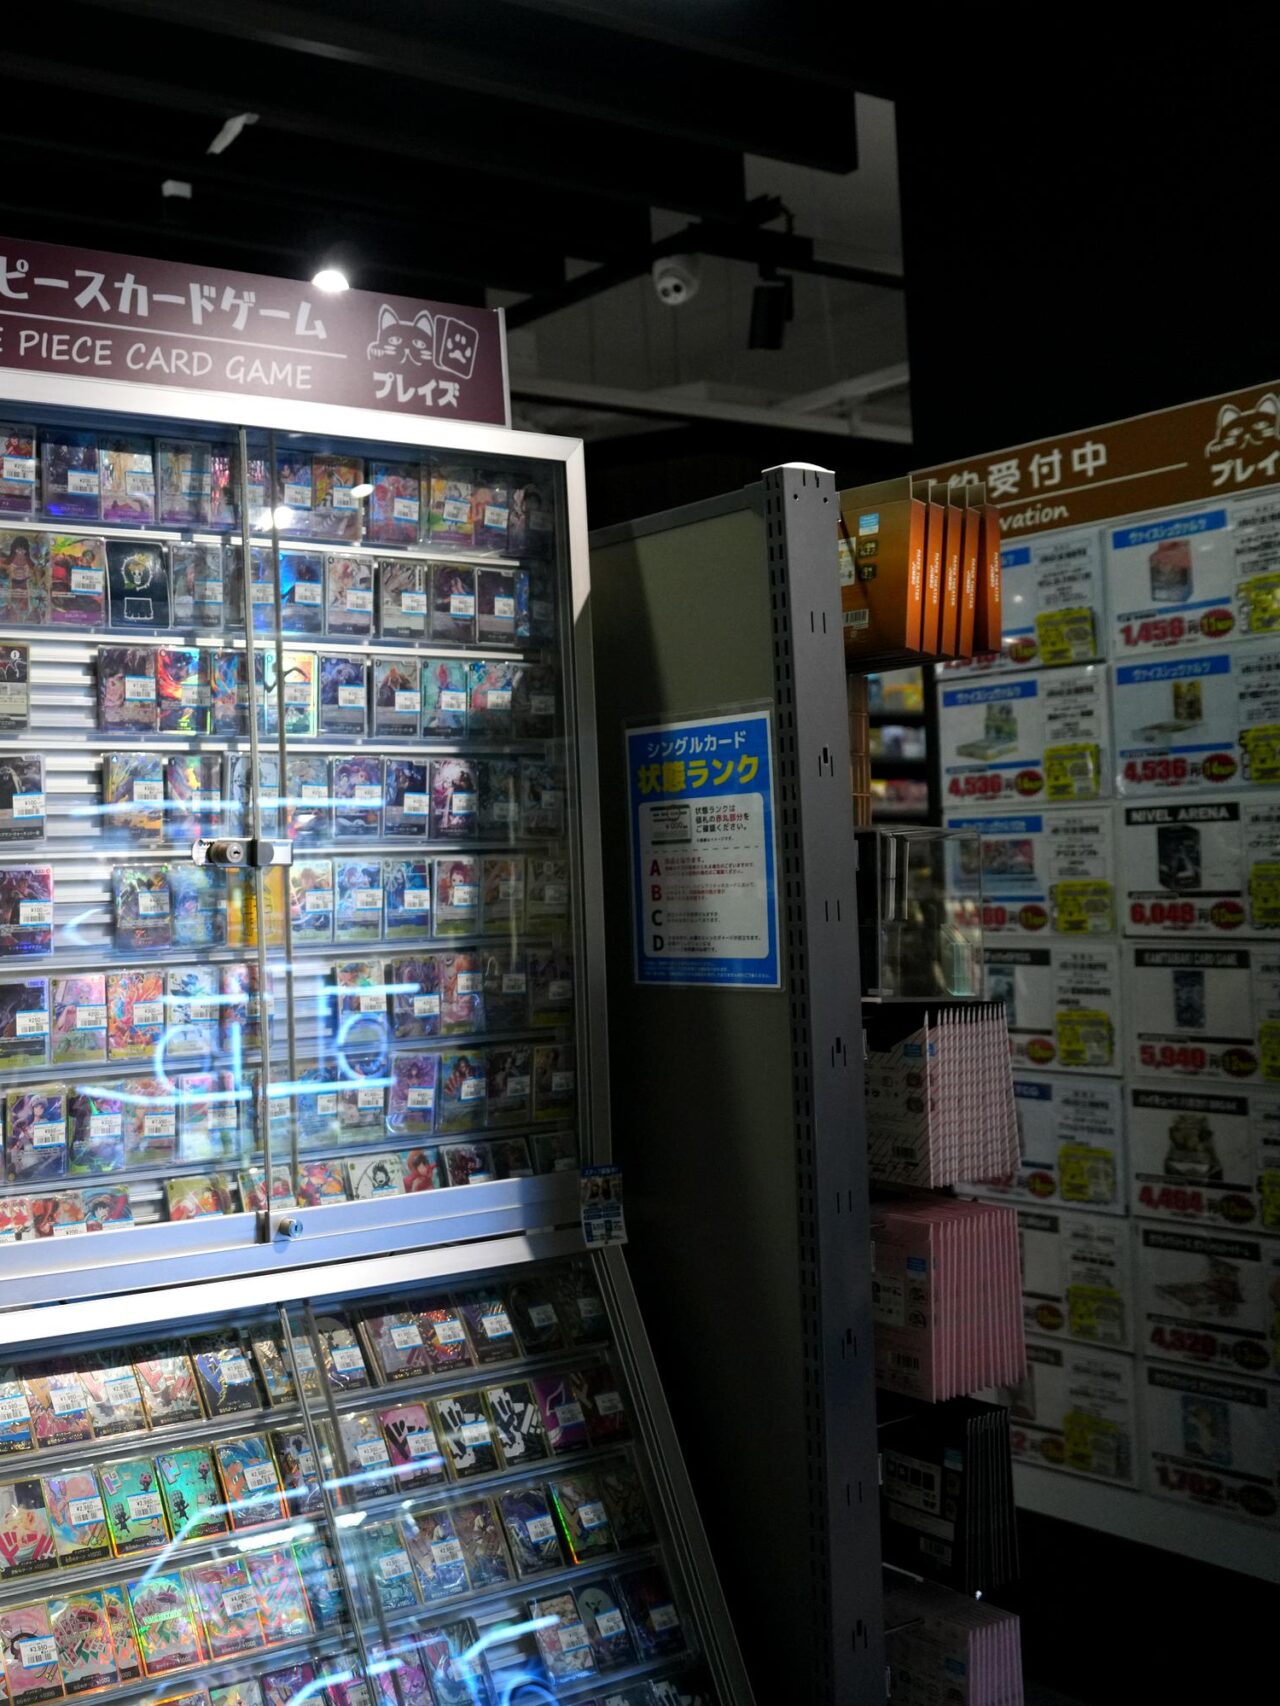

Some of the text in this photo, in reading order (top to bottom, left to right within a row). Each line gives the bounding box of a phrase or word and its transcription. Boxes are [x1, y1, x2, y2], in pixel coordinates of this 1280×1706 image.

[19, 329, 113, 366] PIECE
[125, 342, 213, 377] CARD
[225, 354, 313, 390] GAME
[372, 370, 460, 409] プレイズ
[930, 441, 1107, 498] 受付中
[647, 731, 746, 758] シングルカード
[637, 754, 760, 794] 状態ランク
[1130, 805, 1230, 823] NIVEL ARENA
[650, 859, 661, 876] A
[651, 885, 662, 902] B
[651, 909, 662, 926] C
[653, 935, 664, 952] D
